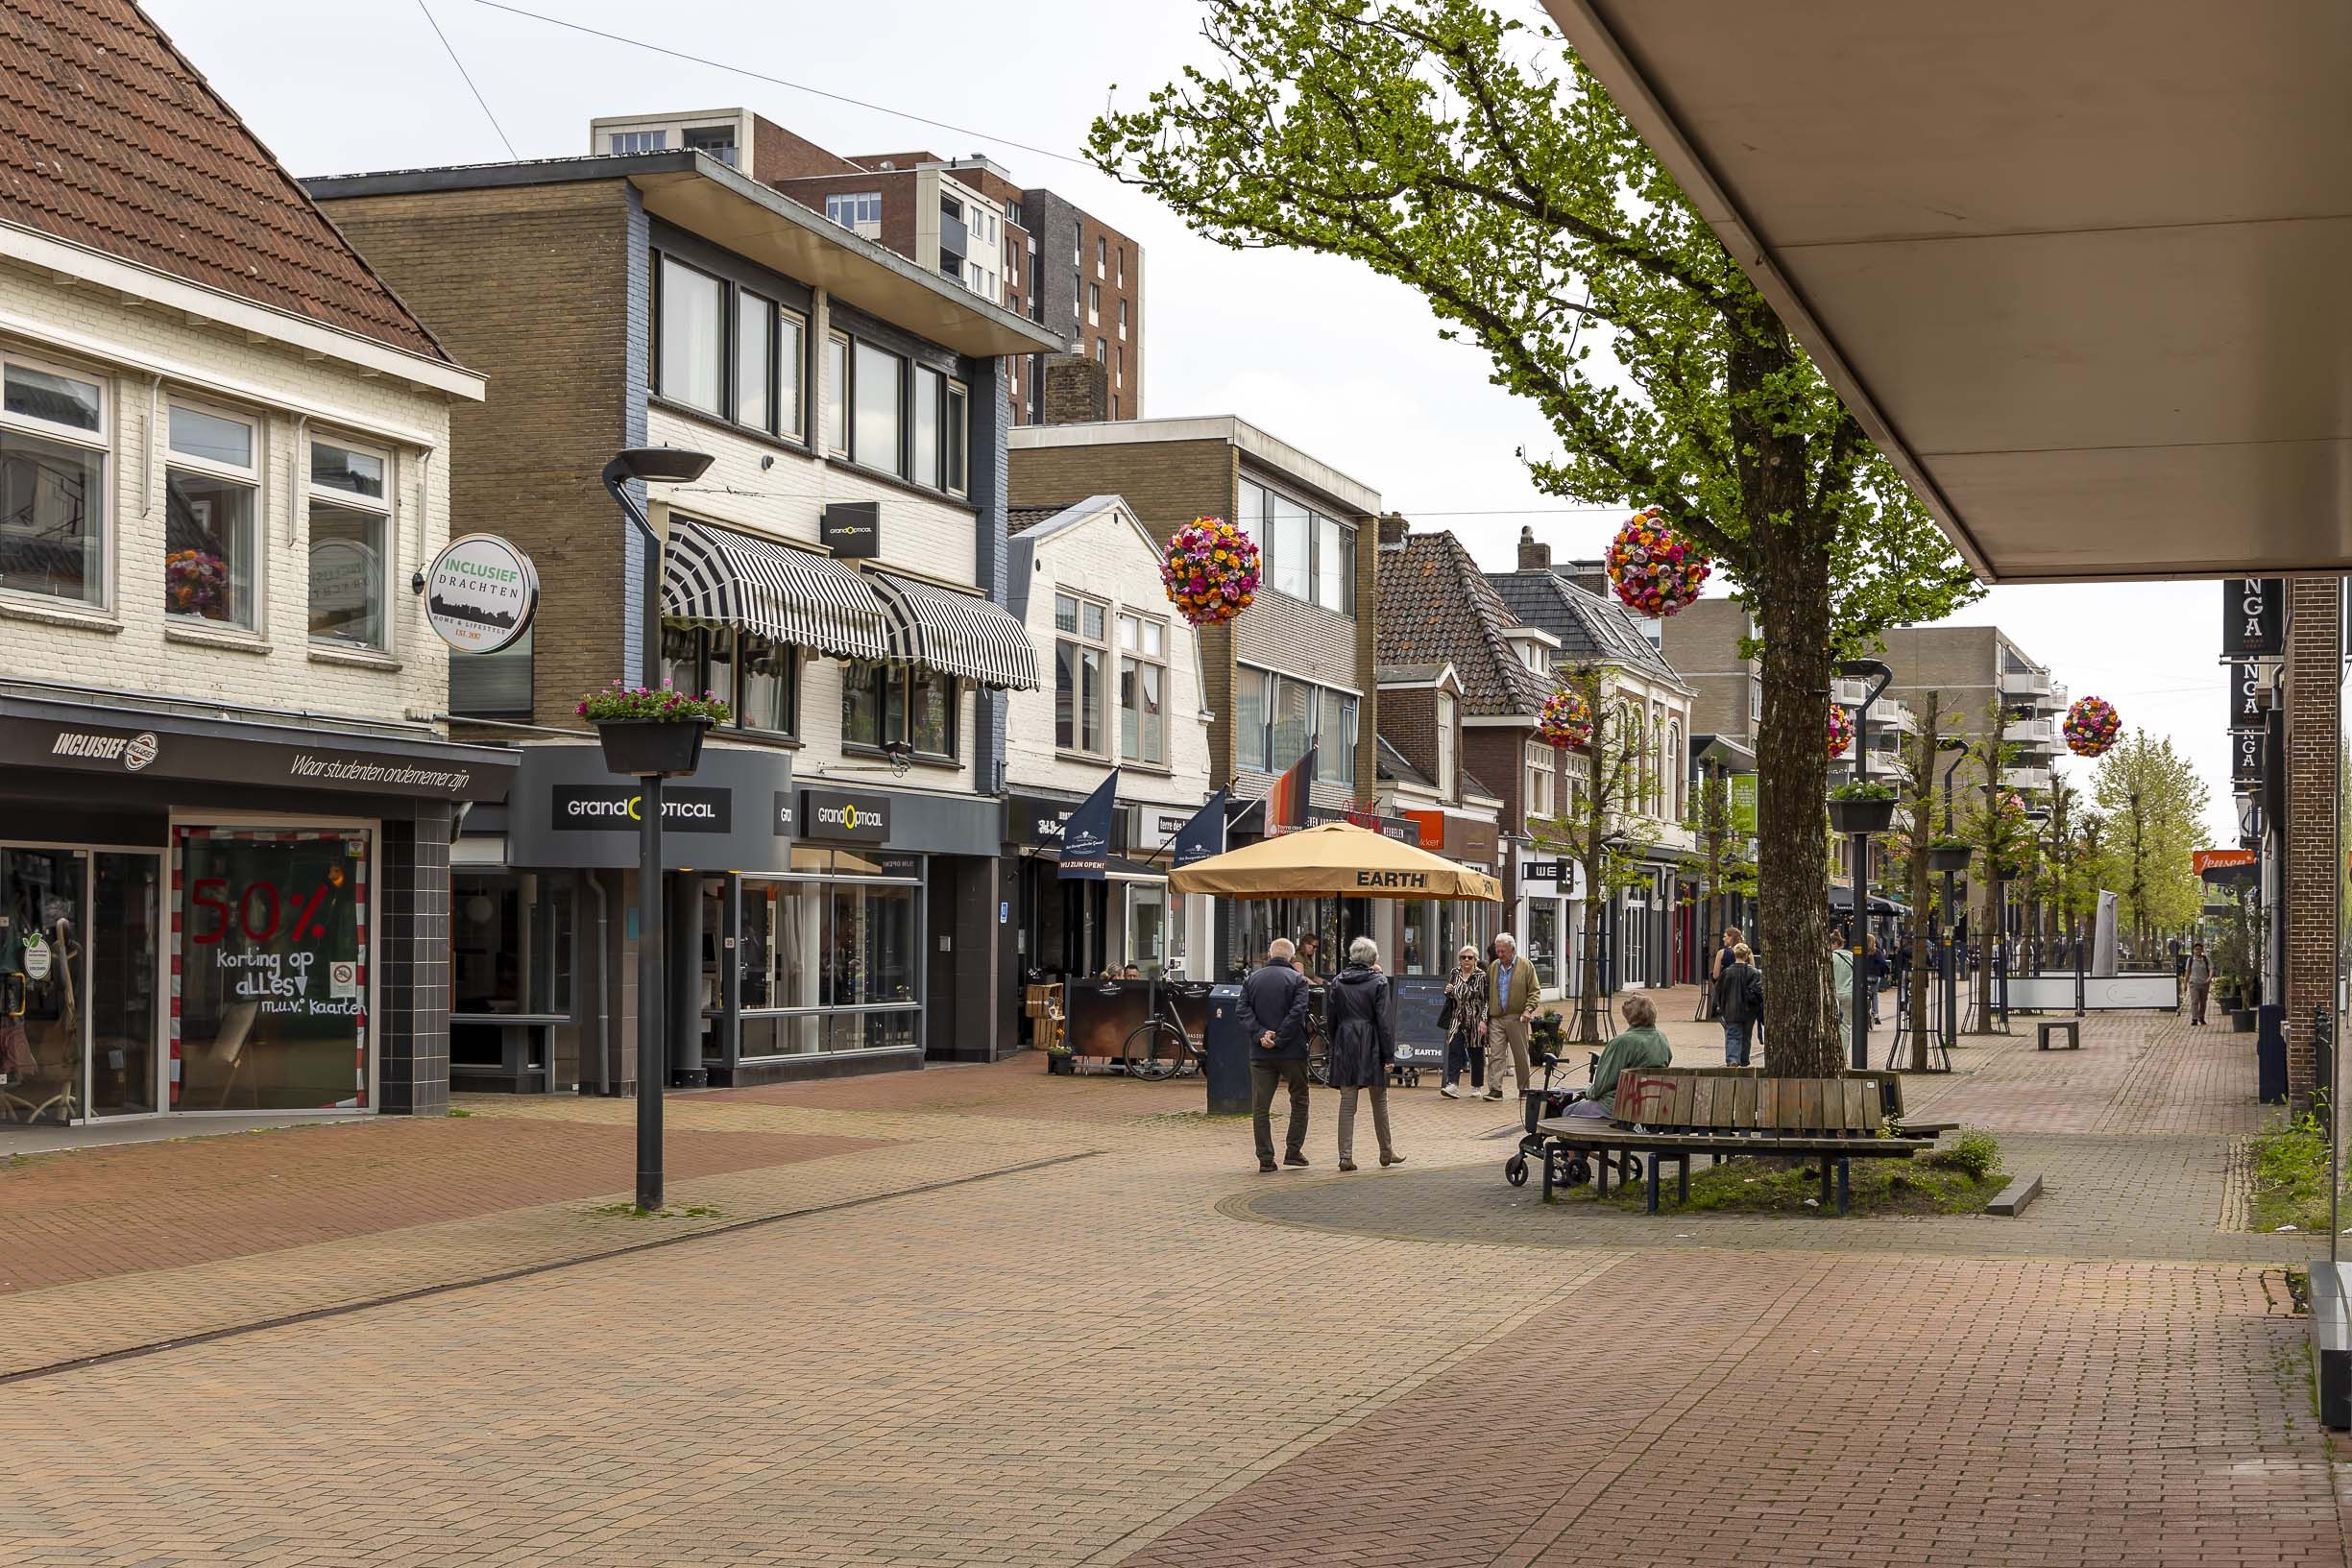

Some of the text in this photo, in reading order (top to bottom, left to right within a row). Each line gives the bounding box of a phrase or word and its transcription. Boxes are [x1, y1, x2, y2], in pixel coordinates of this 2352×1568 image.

[445, 558, 519, 583] INCLUSIEF
[438, 574, 519, 598] DRACHTEN
[433, 615, 454, 625] HOME
[466, 622, 506, 635] LIFESTYLE
[52, 733, 127, 760] INCLUSIEF
[290, 754, 470, 792] Waar studenten ondernemer zijn
[1160, 818, 1173, 831] terre
[1174, 819, 1182, 832] des
[1383, 827, 1404, 838] MEUBELEN
[1357, 871, 1423, 888] EARTH
[192, 879, 329, 945] 50%
[289, 952, 314, 977] op
